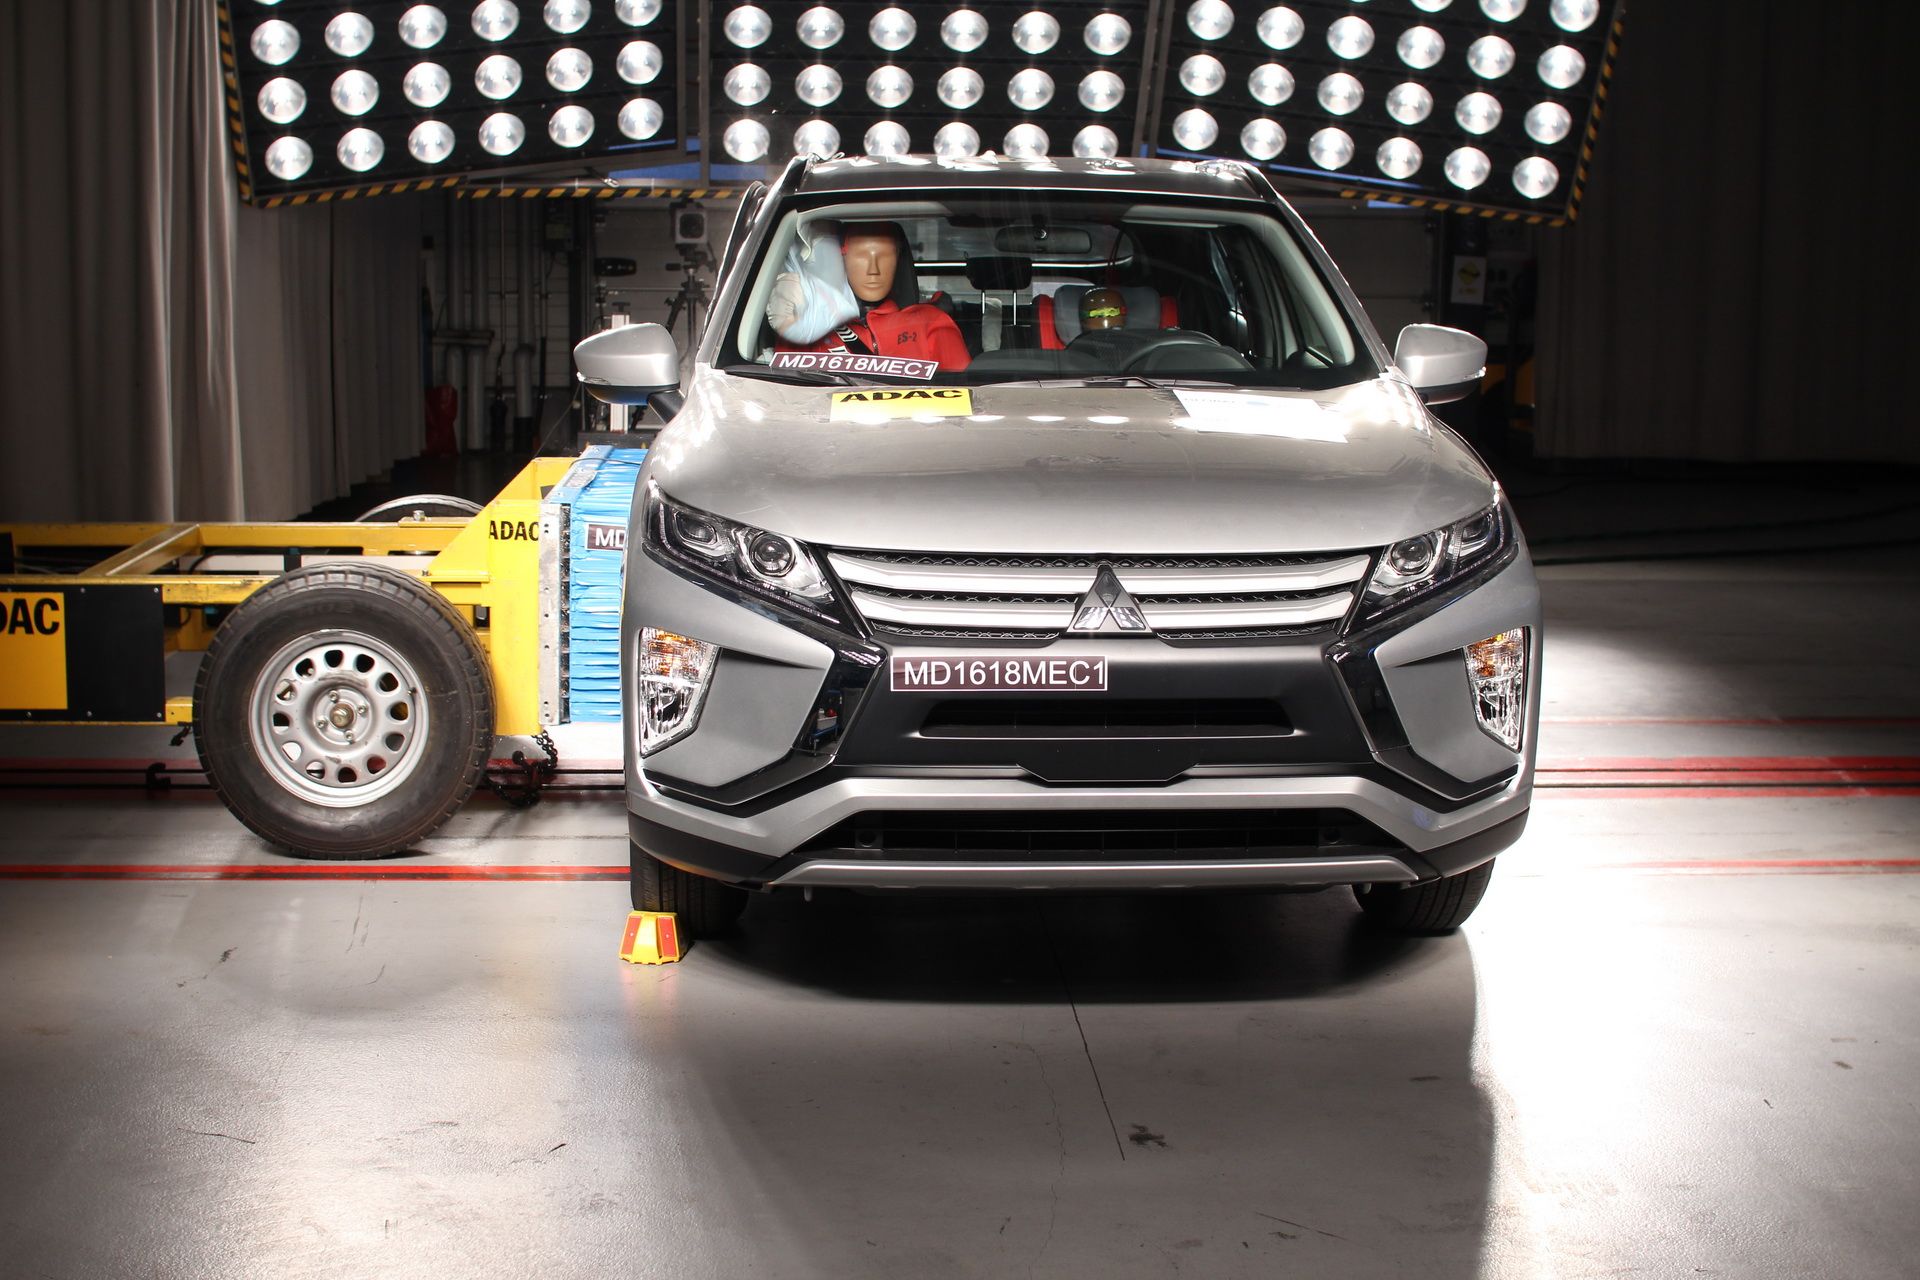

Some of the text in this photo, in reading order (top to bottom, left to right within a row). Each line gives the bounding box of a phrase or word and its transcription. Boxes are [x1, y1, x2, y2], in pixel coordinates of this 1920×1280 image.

[778, 354, 934, 377] MD1618MEC1
[839, 389, 962, 403] ADAC
[903, 660, 1105, 686] MD1618MEC1
